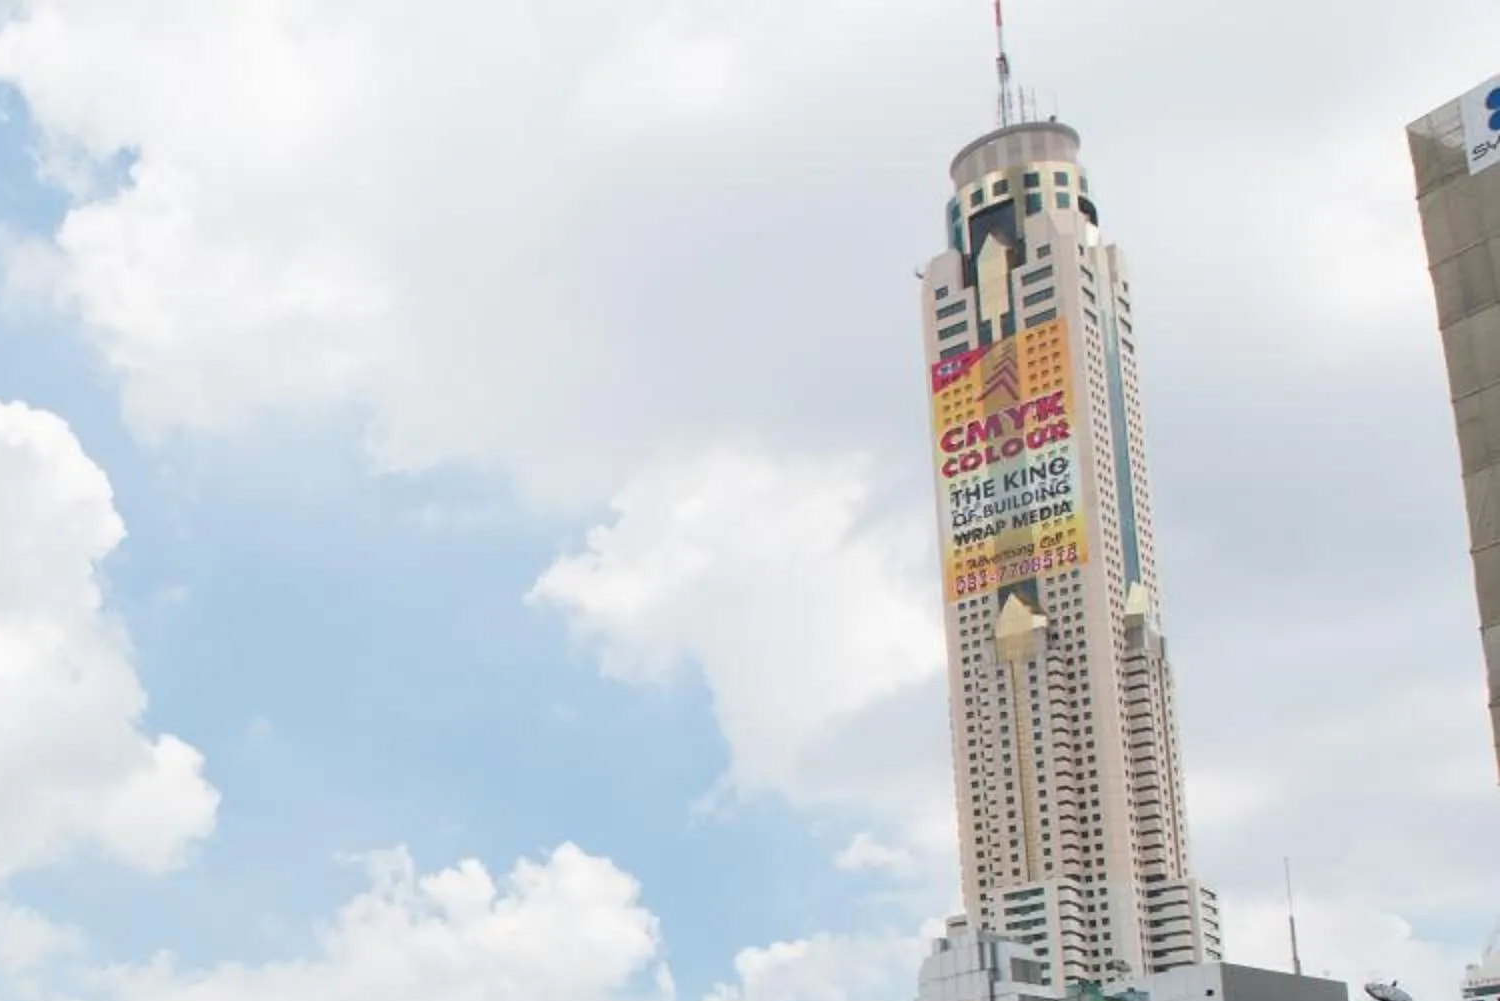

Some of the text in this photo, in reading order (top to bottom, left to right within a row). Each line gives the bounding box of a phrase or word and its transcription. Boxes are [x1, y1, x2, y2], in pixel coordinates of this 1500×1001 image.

[940, 391, 1065, 453] CMYK
[941, 420, 1071, 479] COLOUR
[951, 457, 1068, 508] THE KING
[983, 481, 1071, 518] BUILDING
[954, 500, 1072, 546] WRAP MEDIA
